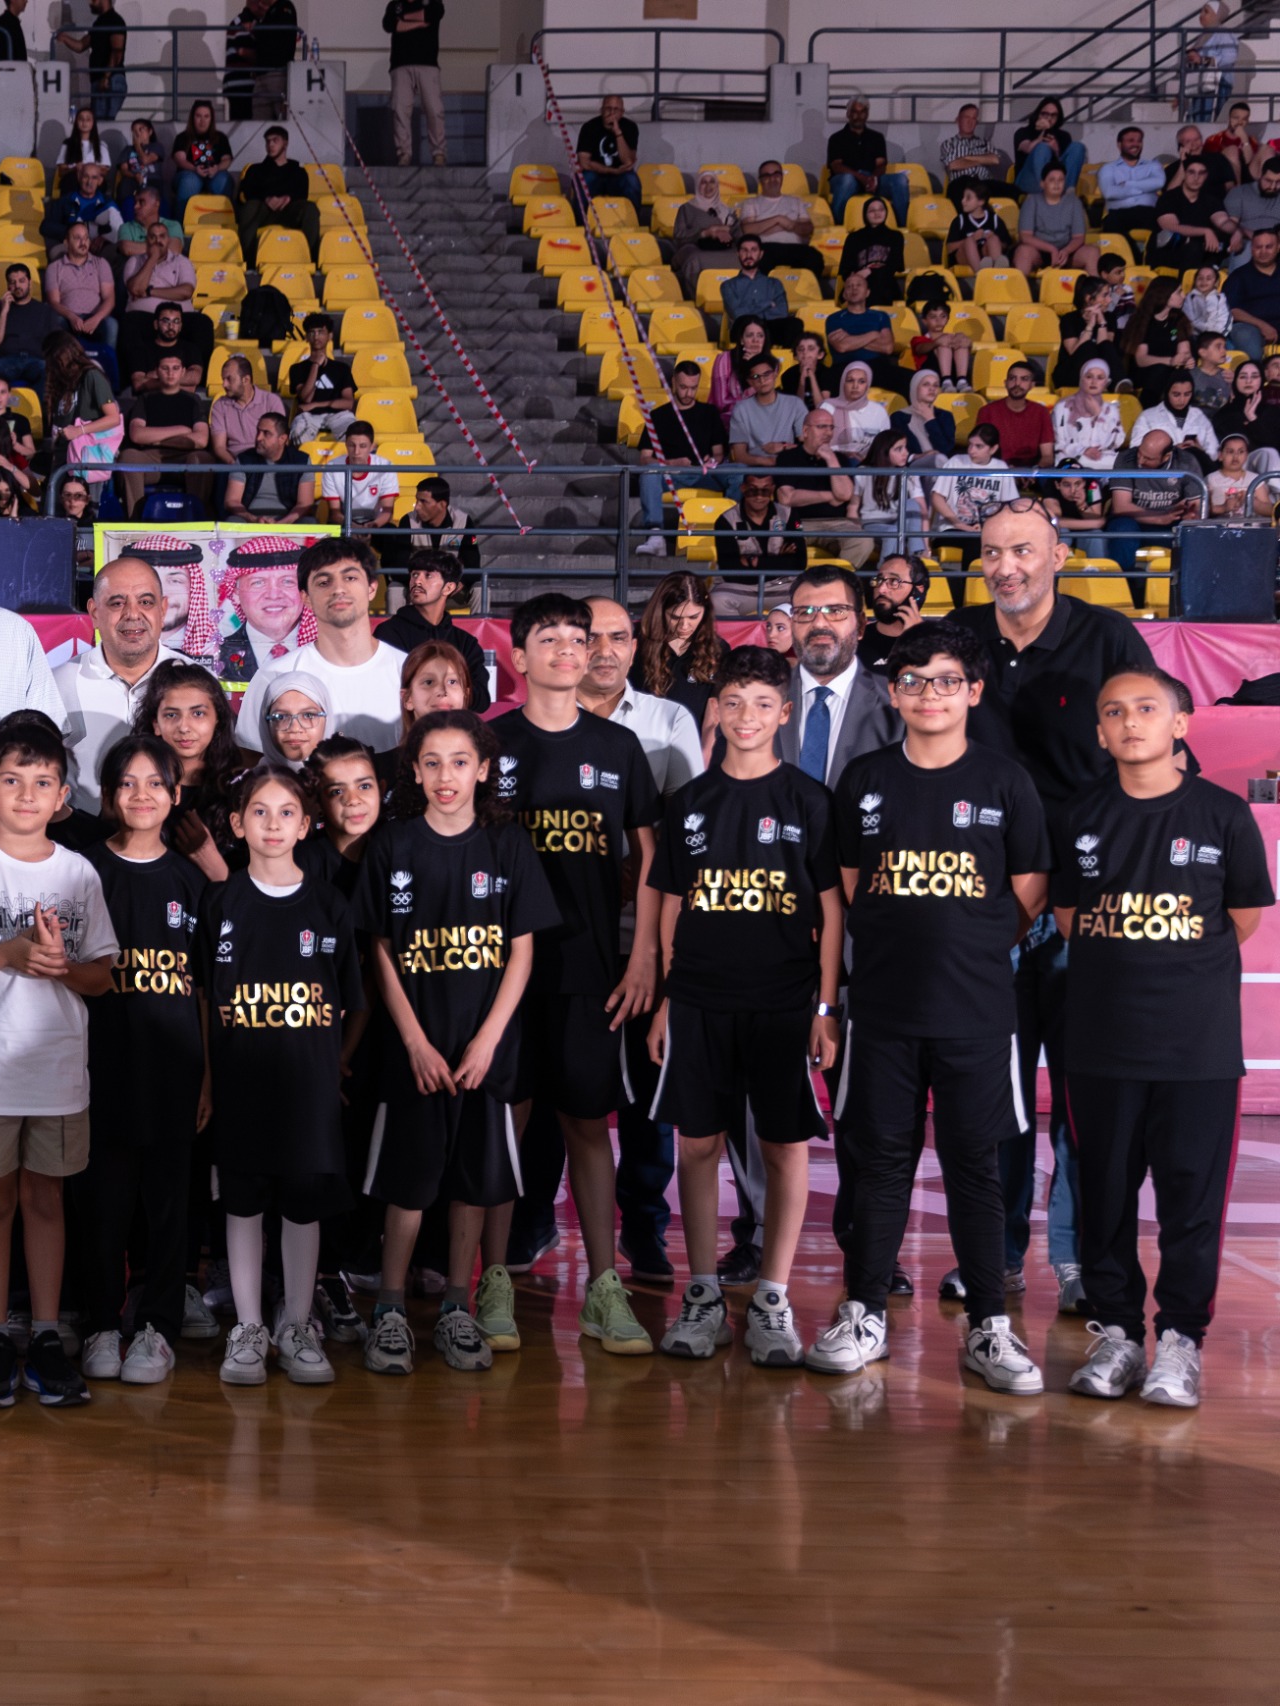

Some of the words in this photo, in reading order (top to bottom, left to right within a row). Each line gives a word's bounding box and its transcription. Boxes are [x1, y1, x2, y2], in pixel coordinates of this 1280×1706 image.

[42, 69, 61, 93] H
[307, 69, 325, 92] H
[1133, 489, 1180, 502] Emirates
[518, 809, 604, 832] UNIOR
[531, 829, 608, 856] LCONS
[877, 850, 977, 874] JUNIOR
[473, 887, 487, 895] JBF
[692, 868, 787, 891] JUNIOR
[868, 871, 987, 899] FALCONS
[1091, 891, 1193, 916] JUNIOR
[408, 924, 503, 950] JUNIOR
[1078, 914, 1205, 941] FALCONS
[114, 948, 188, 973] UNIOR
[398, 945, 504, 974] FALCON
[112, 969, 194, 997] LCONS
[230, 981, 324, 1005] JUNIOR
[218, 1003, 333, 1028] FALCONS
